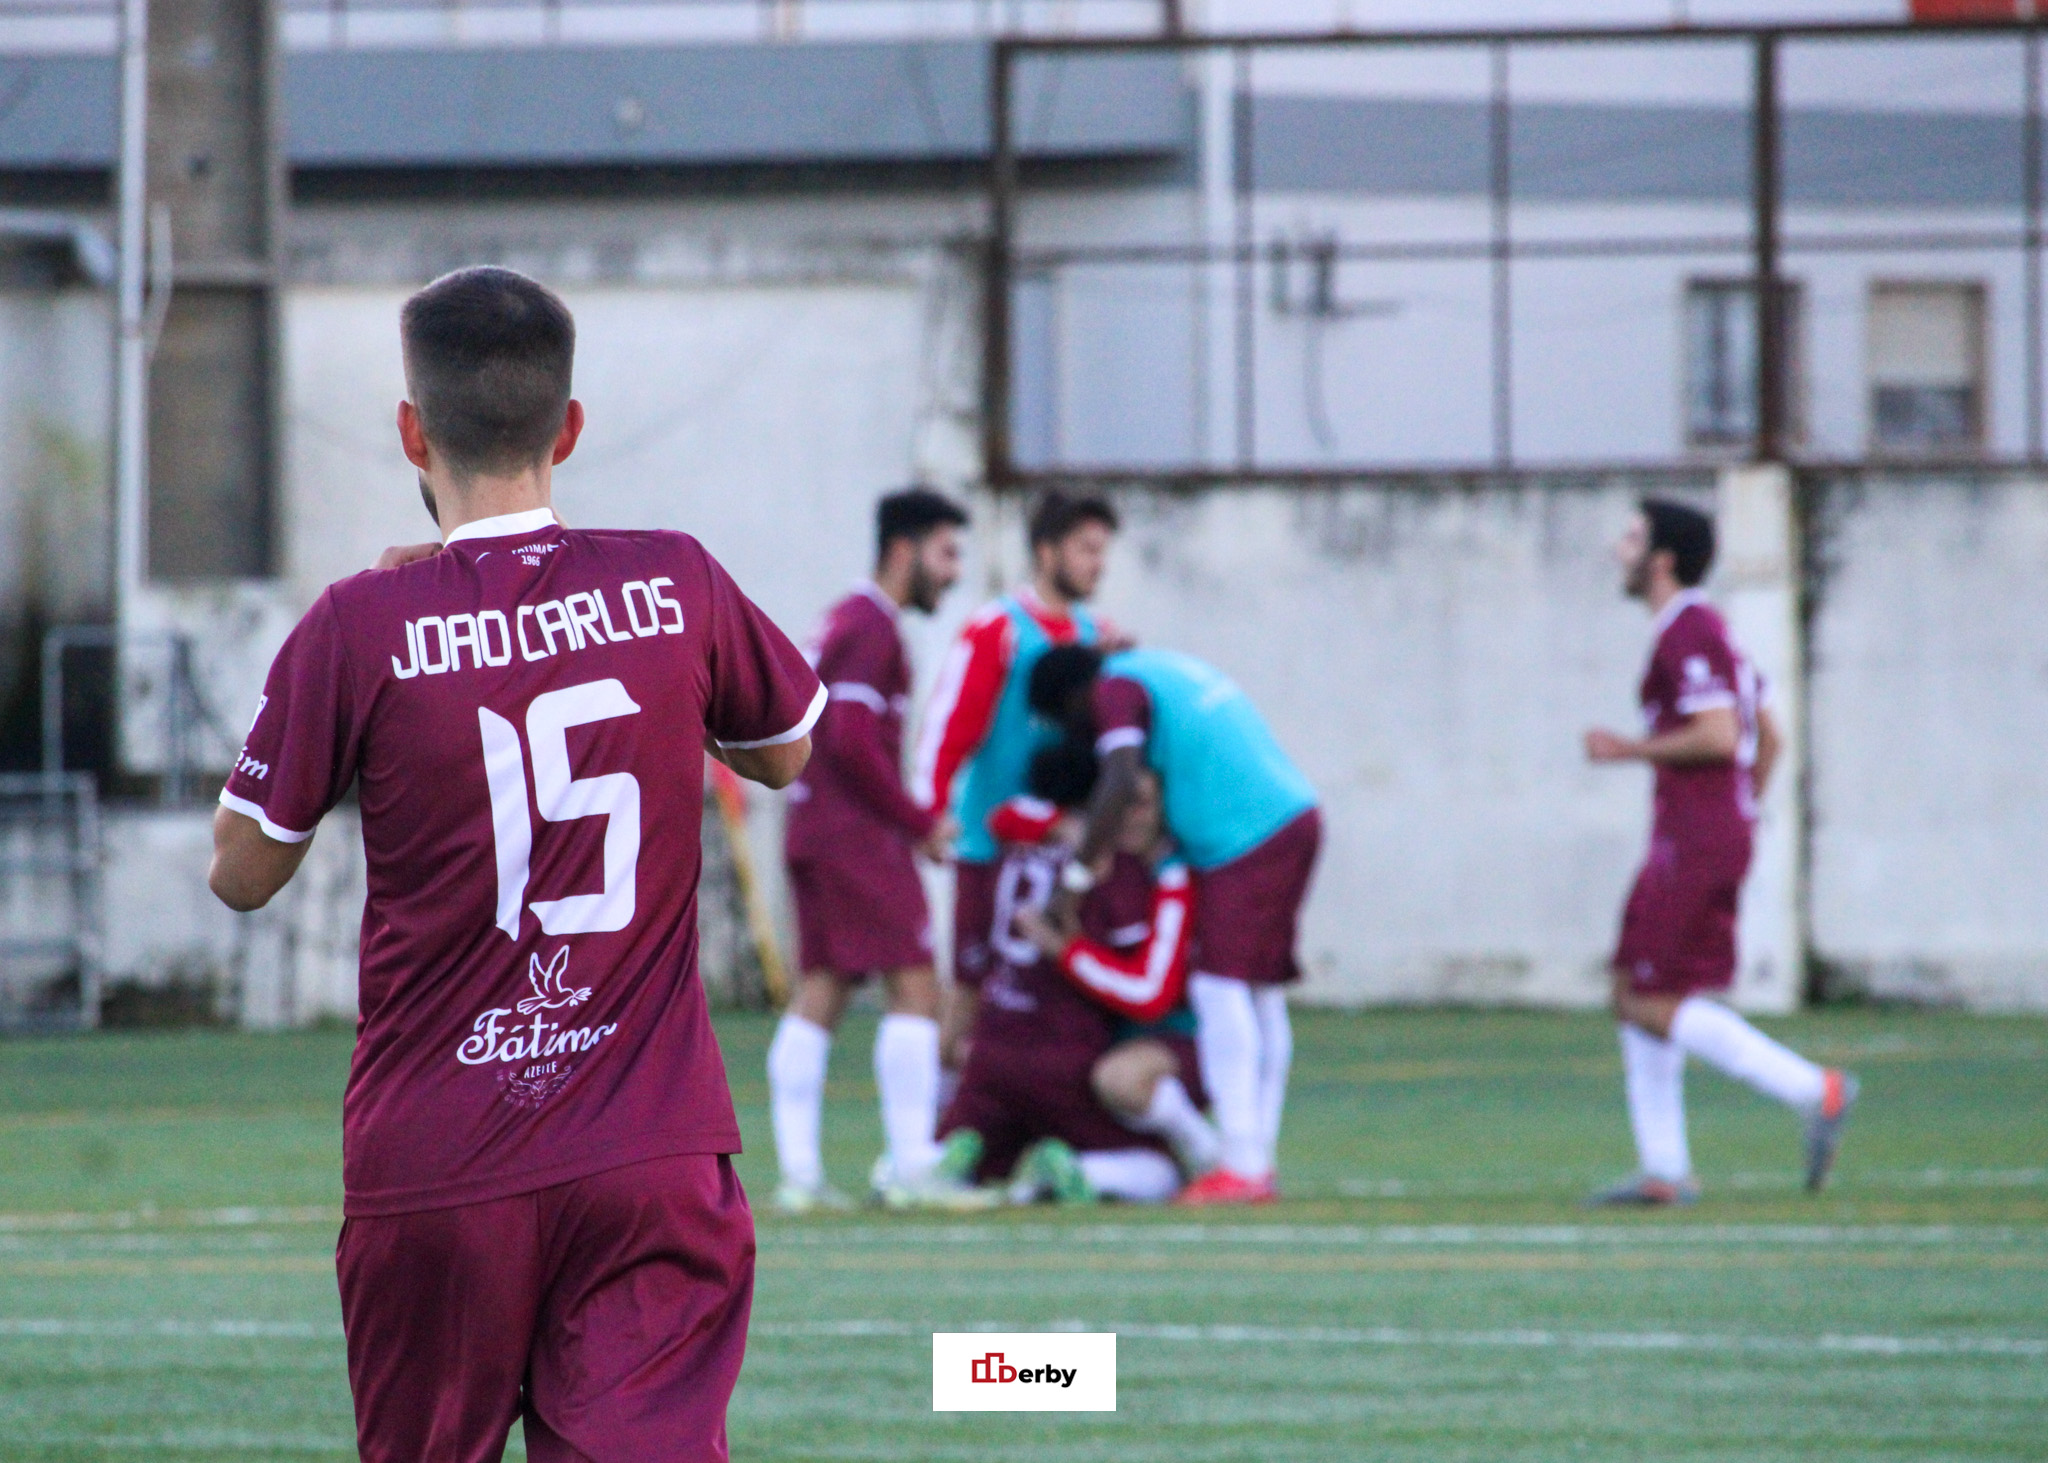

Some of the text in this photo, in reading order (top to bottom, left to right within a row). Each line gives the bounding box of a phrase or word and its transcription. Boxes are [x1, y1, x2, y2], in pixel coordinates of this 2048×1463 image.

[521, 555, 541, 567] 1966
[391, 577, 684, 679] JOAO CARLOS
[478, 678, 642, 941] 15
[523, 1061, 557, 1079] AZEITE
